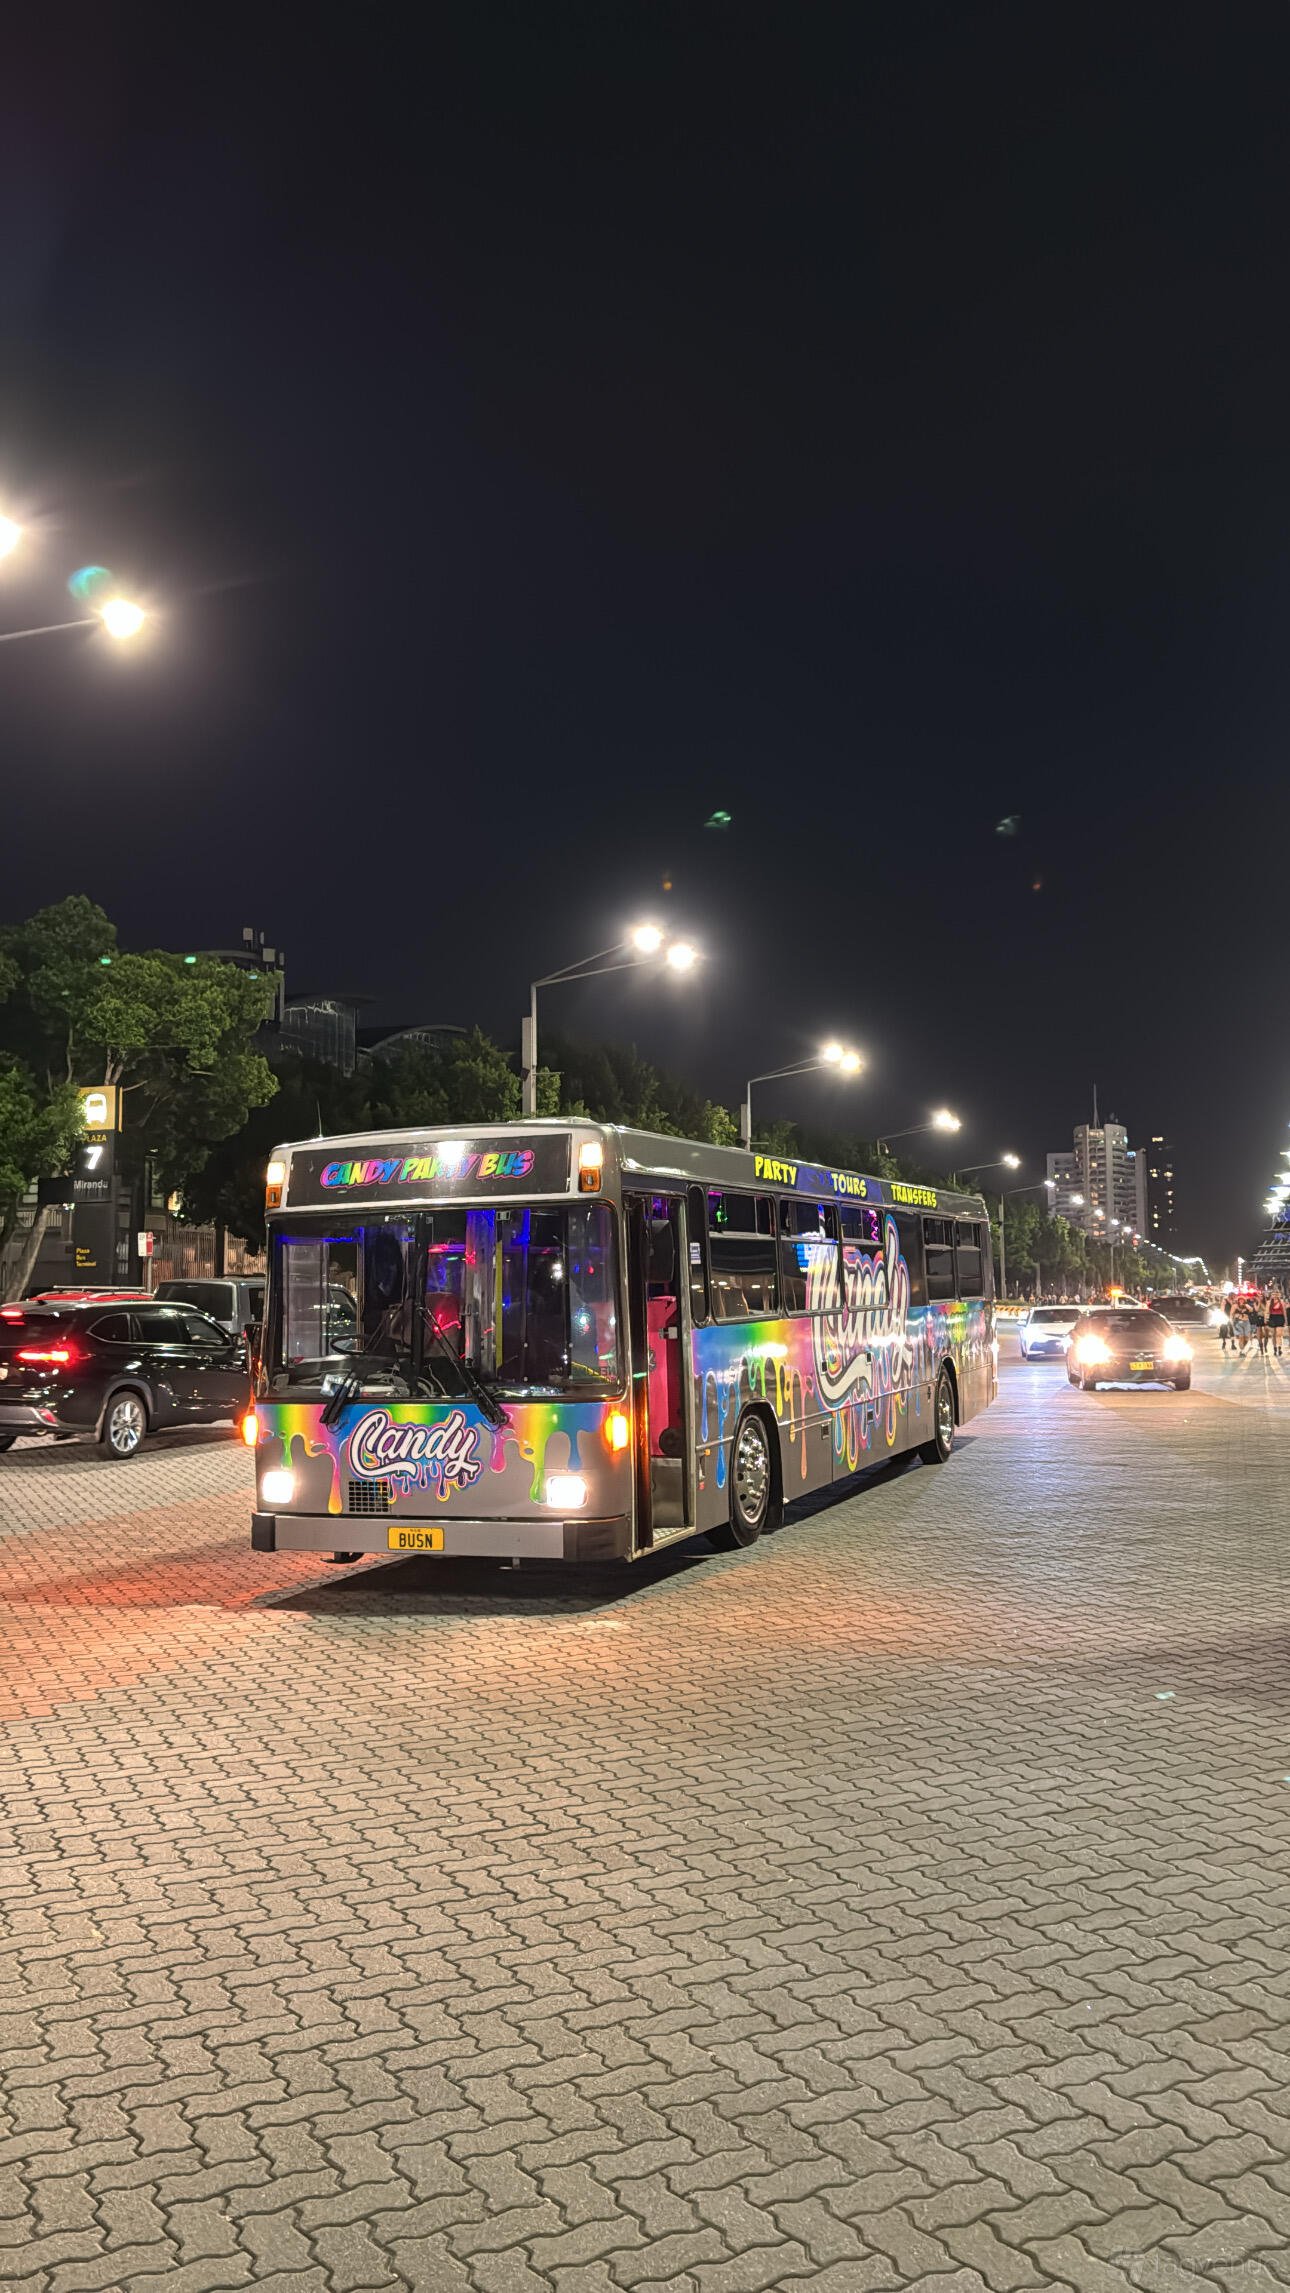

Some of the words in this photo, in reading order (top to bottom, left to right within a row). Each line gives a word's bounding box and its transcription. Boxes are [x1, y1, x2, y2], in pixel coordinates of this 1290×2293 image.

[86, 1145, 104, 1170] 7
[321, 1158, 401, 1188] CANDY
[476, 1150, 535, 1179] BUS
[755, 1156, 797, 1185] PARTY
[831, 1173, 867, 1198] TOURS
[891, 1184, 937, 1208] TRANSFERS
[810, 1224, 914, 1402] Candy
[350, 1410, 481, 1481] Candy
[399, 1532, 433, 1549] BUSN
